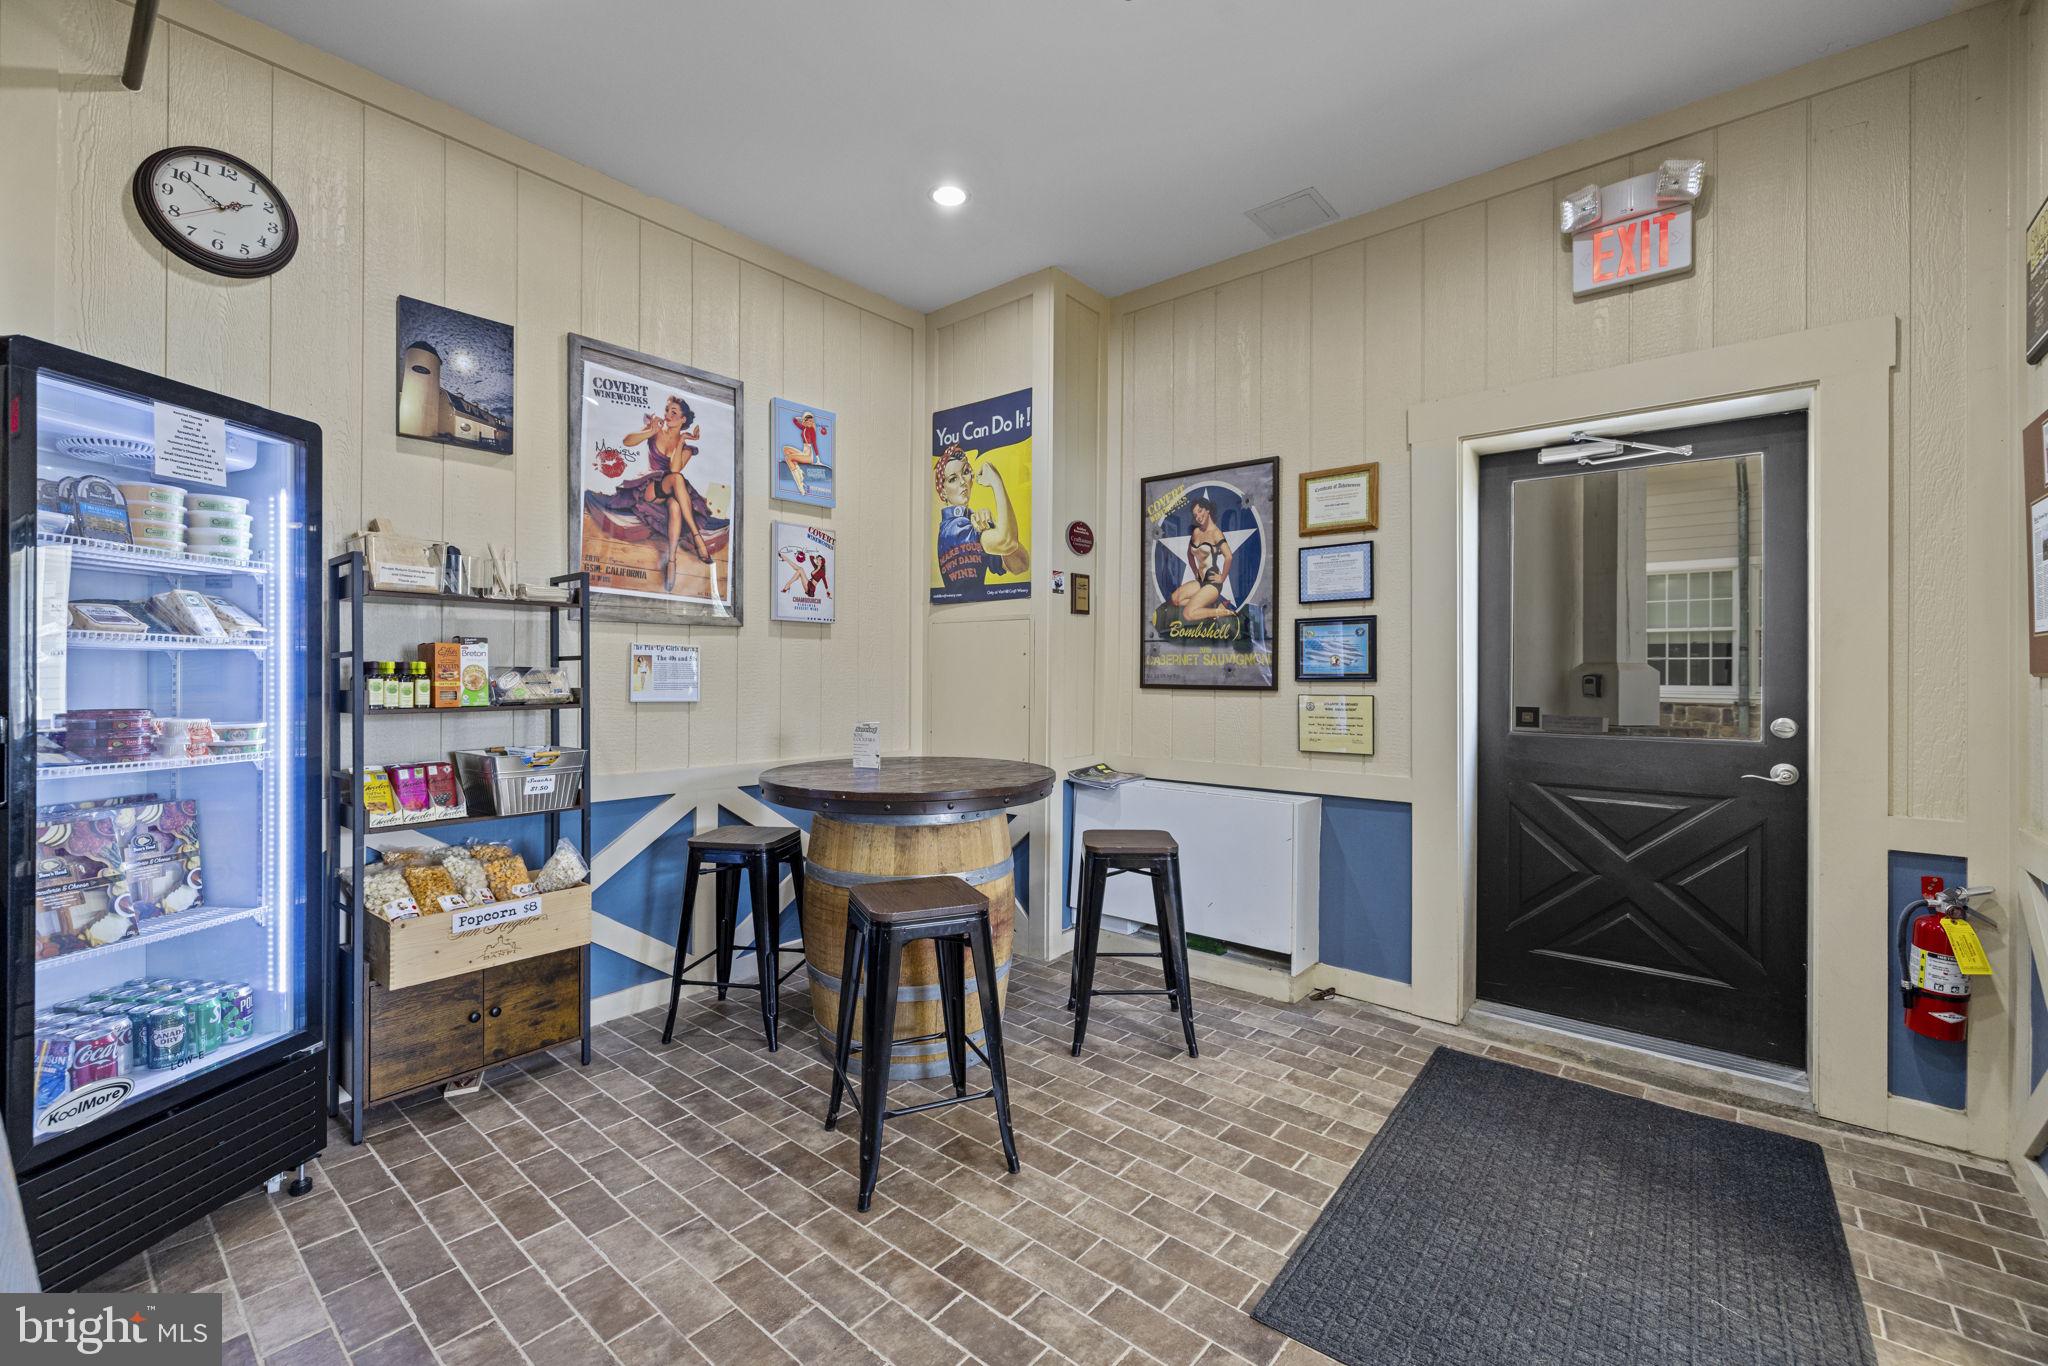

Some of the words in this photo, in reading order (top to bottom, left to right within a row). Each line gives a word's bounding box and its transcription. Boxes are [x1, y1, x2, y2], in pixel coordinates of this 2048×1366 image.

[170, 168, 191, 183] 10
[193, 161, 211, 176] 11
[218, 166, 238, 182] 12
[161, 183, 173, 195] 9
[248, 182, 258, 194] 1
[168, 204, 180, 217] 8
[264, 202, 274, 214] 2
[186, 225, 197, 236] 7
[268, 222, 278, 234] 3
[212, 239, 224, 250] 6
[240, 244, 250, 255] 5
[257, 236, 268, 248] 4
[1593, 212, 1676, 283] EXIT
[593, 377, 648, 396] COVERT
[593, 389, 648, 404] WINEWORKS
[936, 428, 959, 446] You
[962, 421, 989, 440] Can
[992, 415, 1012, 434] Do
[1016, 407, 1031, 429] It!
[596, 438, 640, 462] Monique
[808, 527, 836, 545] COVERT
[940, 547, 959, 564] MAKE
[606, 565, 647, 579] CALIFORNIA
[941, 559, 958, 574] OWN
[960, 555, 982, 564] DAMN
[949, 568, 977, 581] WINE!
[1169, 620, 1232, 639] Bombshell
[1146, 654, 1199, 666] CABERNET
[459, 908, 517, 927] Popcorn
[523, 902, 538, 913] $8
[152, 1024, 186, 1040] CANADA
[160, 1036, 179, 1045] DRY
[171, 1051, 205, 1070] LOW-E
[48, 1089, 120, 1126] KoolMore
